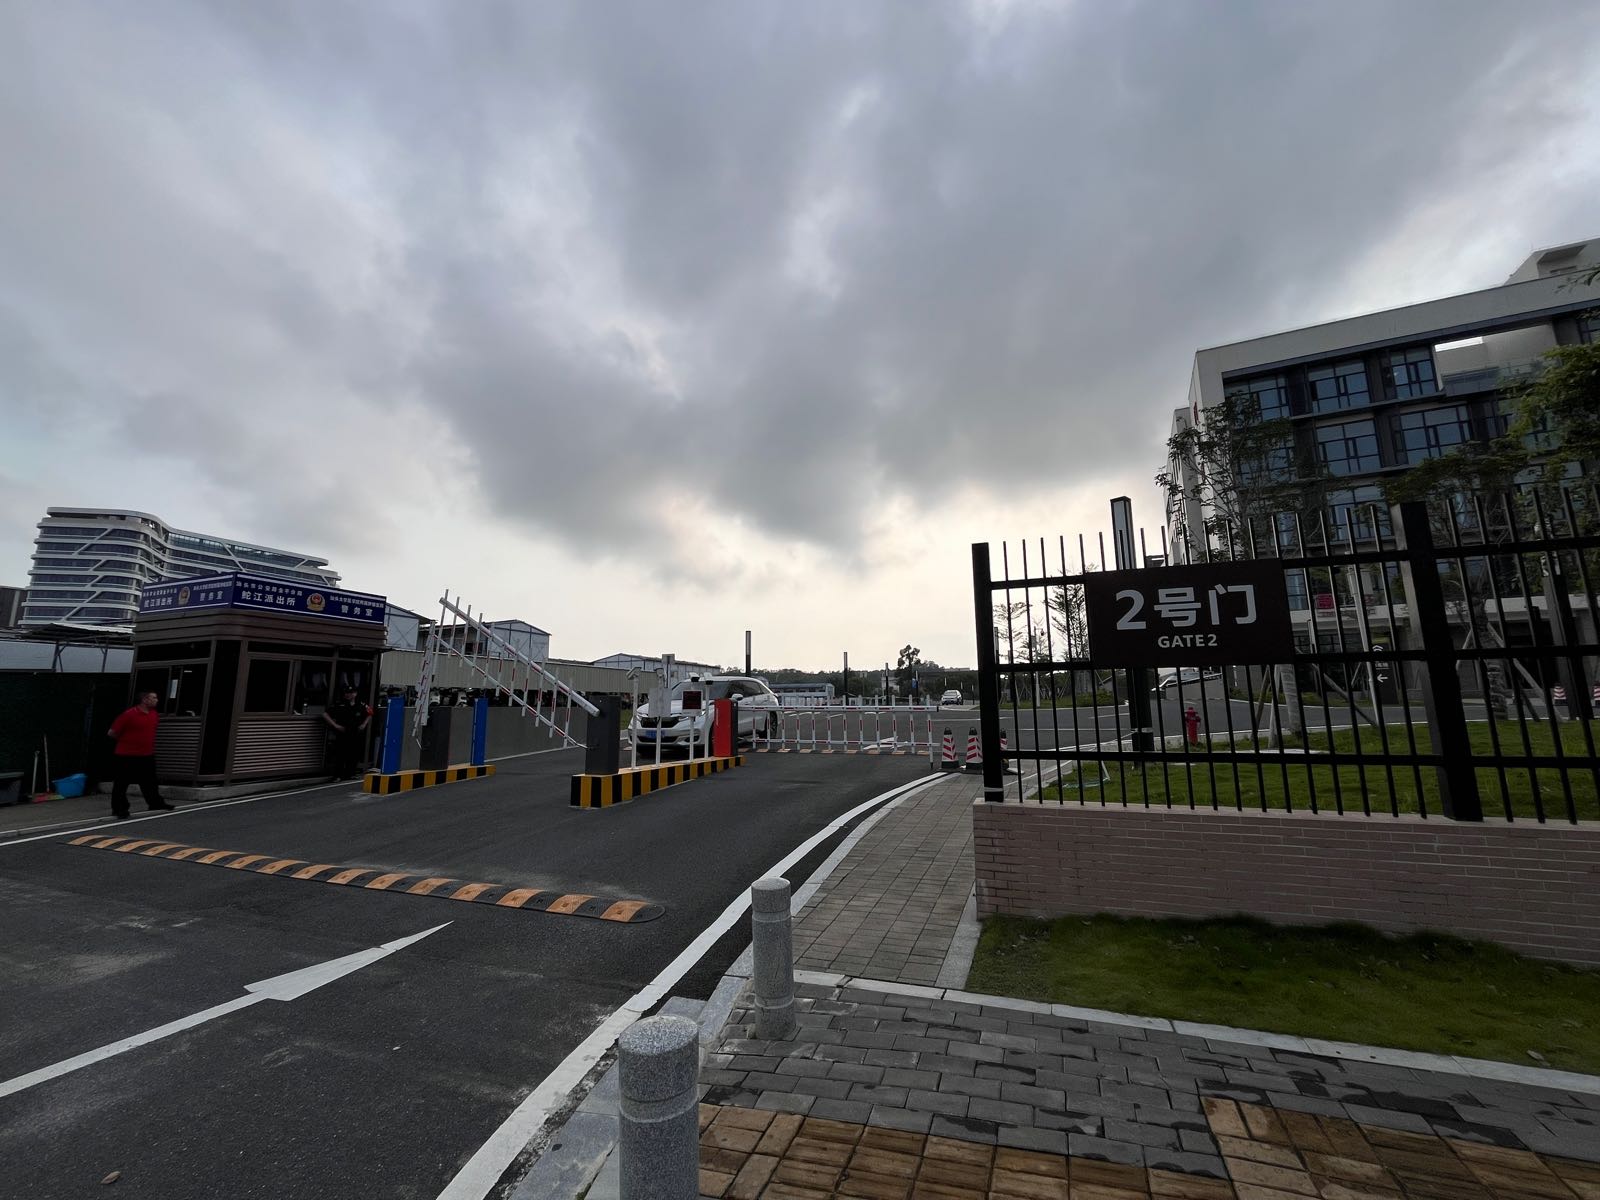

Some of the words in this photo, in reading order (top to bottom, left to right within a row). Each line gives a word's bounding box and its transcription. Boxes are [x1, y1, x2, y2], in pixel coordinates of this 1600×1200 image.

[341, 604, 373, 617] 警务室
[1115, 583, 1257, 630] 2号门
